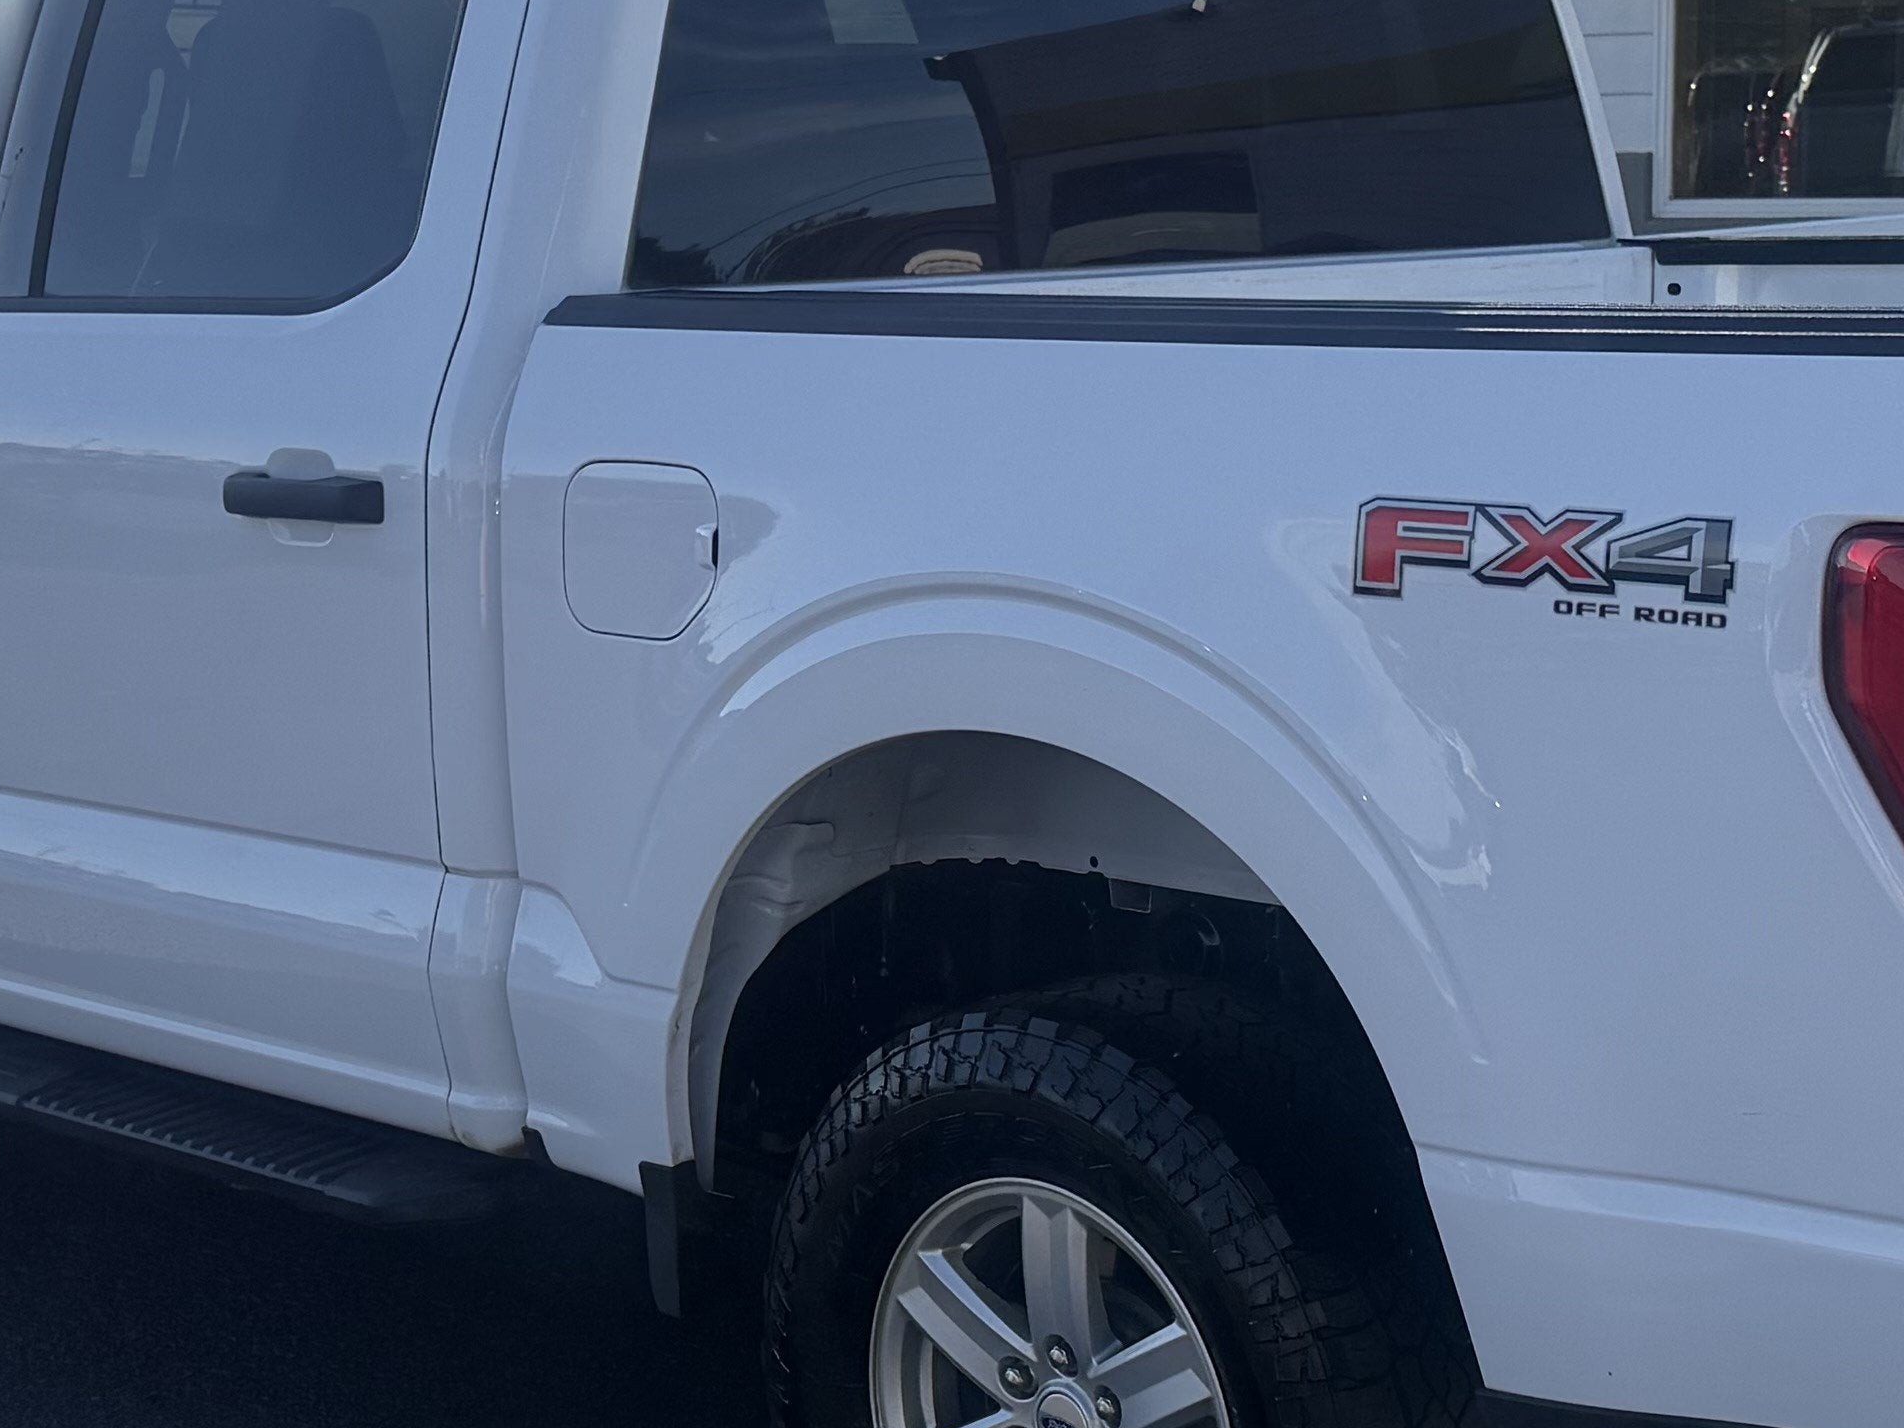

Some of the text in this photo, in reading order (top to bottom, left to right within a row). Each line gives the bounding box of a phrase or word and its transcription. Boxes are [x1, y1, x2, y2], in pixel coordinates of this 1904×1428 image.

[1352, 494, 1738, 604] FX4
[1553, 599, 1728, 630] OFF ROAD
